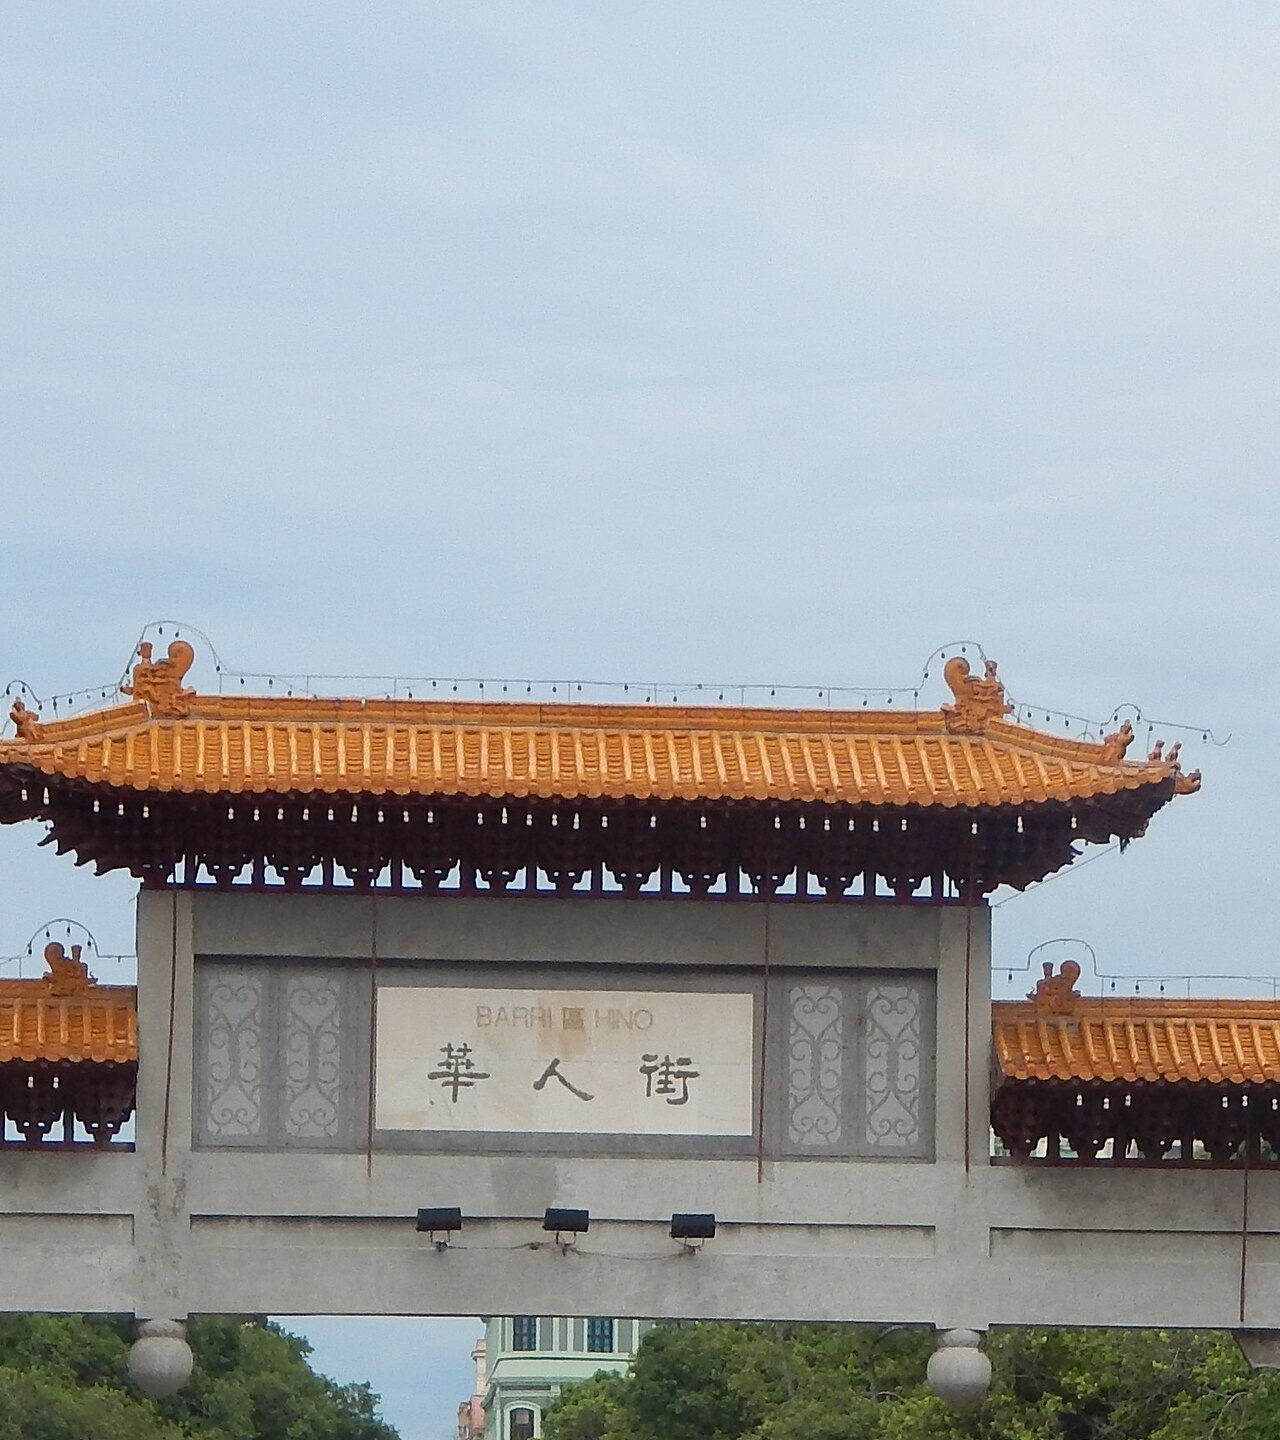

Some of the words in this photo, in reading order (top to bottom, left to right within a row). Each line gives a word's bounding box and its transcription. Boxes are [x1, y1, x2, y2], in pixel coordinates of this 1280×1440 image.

[476, 1006, 552, 1028] BARRI
[595, 1009, 653, 1030] HINO
[427, 1042, 700, 1106] 華人街
